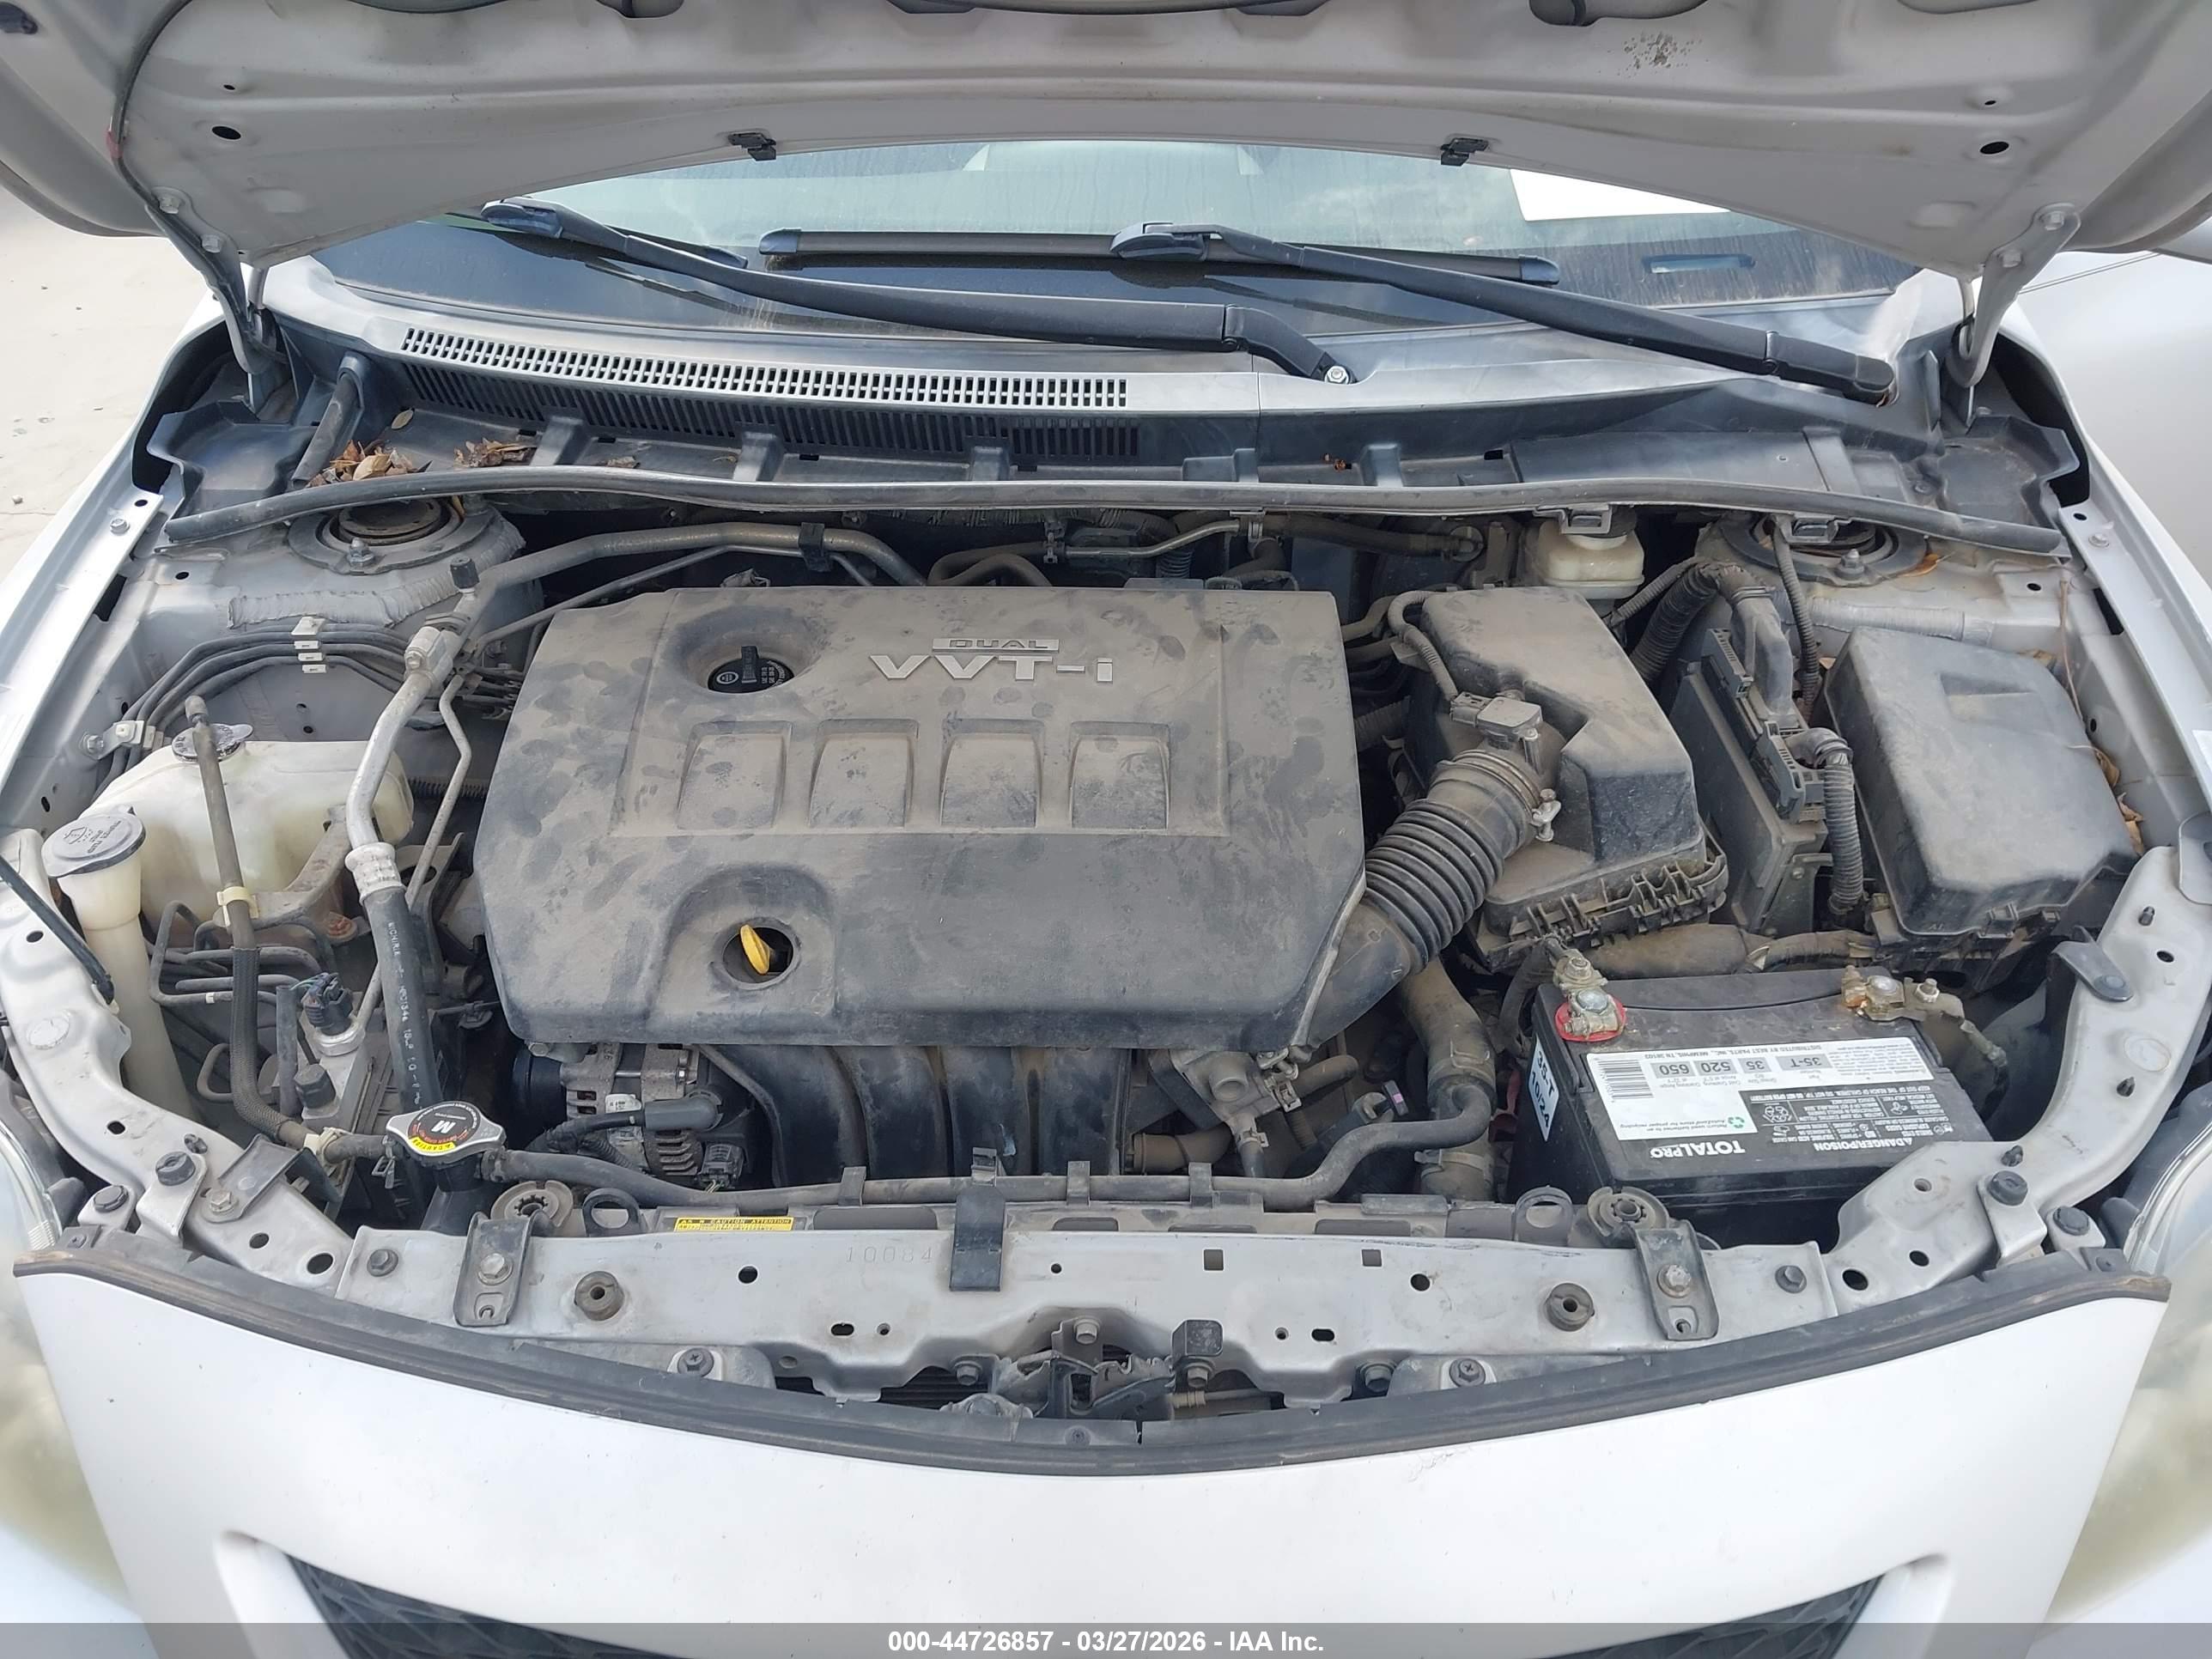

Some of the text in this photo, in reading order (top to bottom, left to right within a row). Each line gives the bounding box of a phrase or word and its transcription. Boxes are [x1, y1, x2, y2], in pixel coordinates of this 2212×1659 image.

[949, 639, 1048, 648] DUAL
[869, 654, 1114, 683] VVT-i
[1699, 1060, 1731, 1072] 520
[1744, 1060, 1765, 1070] 35
[1785, 1056, 1823, 1067] 35-T
[1538, 1051, 1554, 1097] 35-T
[1658, 1063, 1689, 1074] 650
[1532, 1071, 1549, 1127] 10/24
[1650, 1139, 1746, 1159] TOTALPRO
